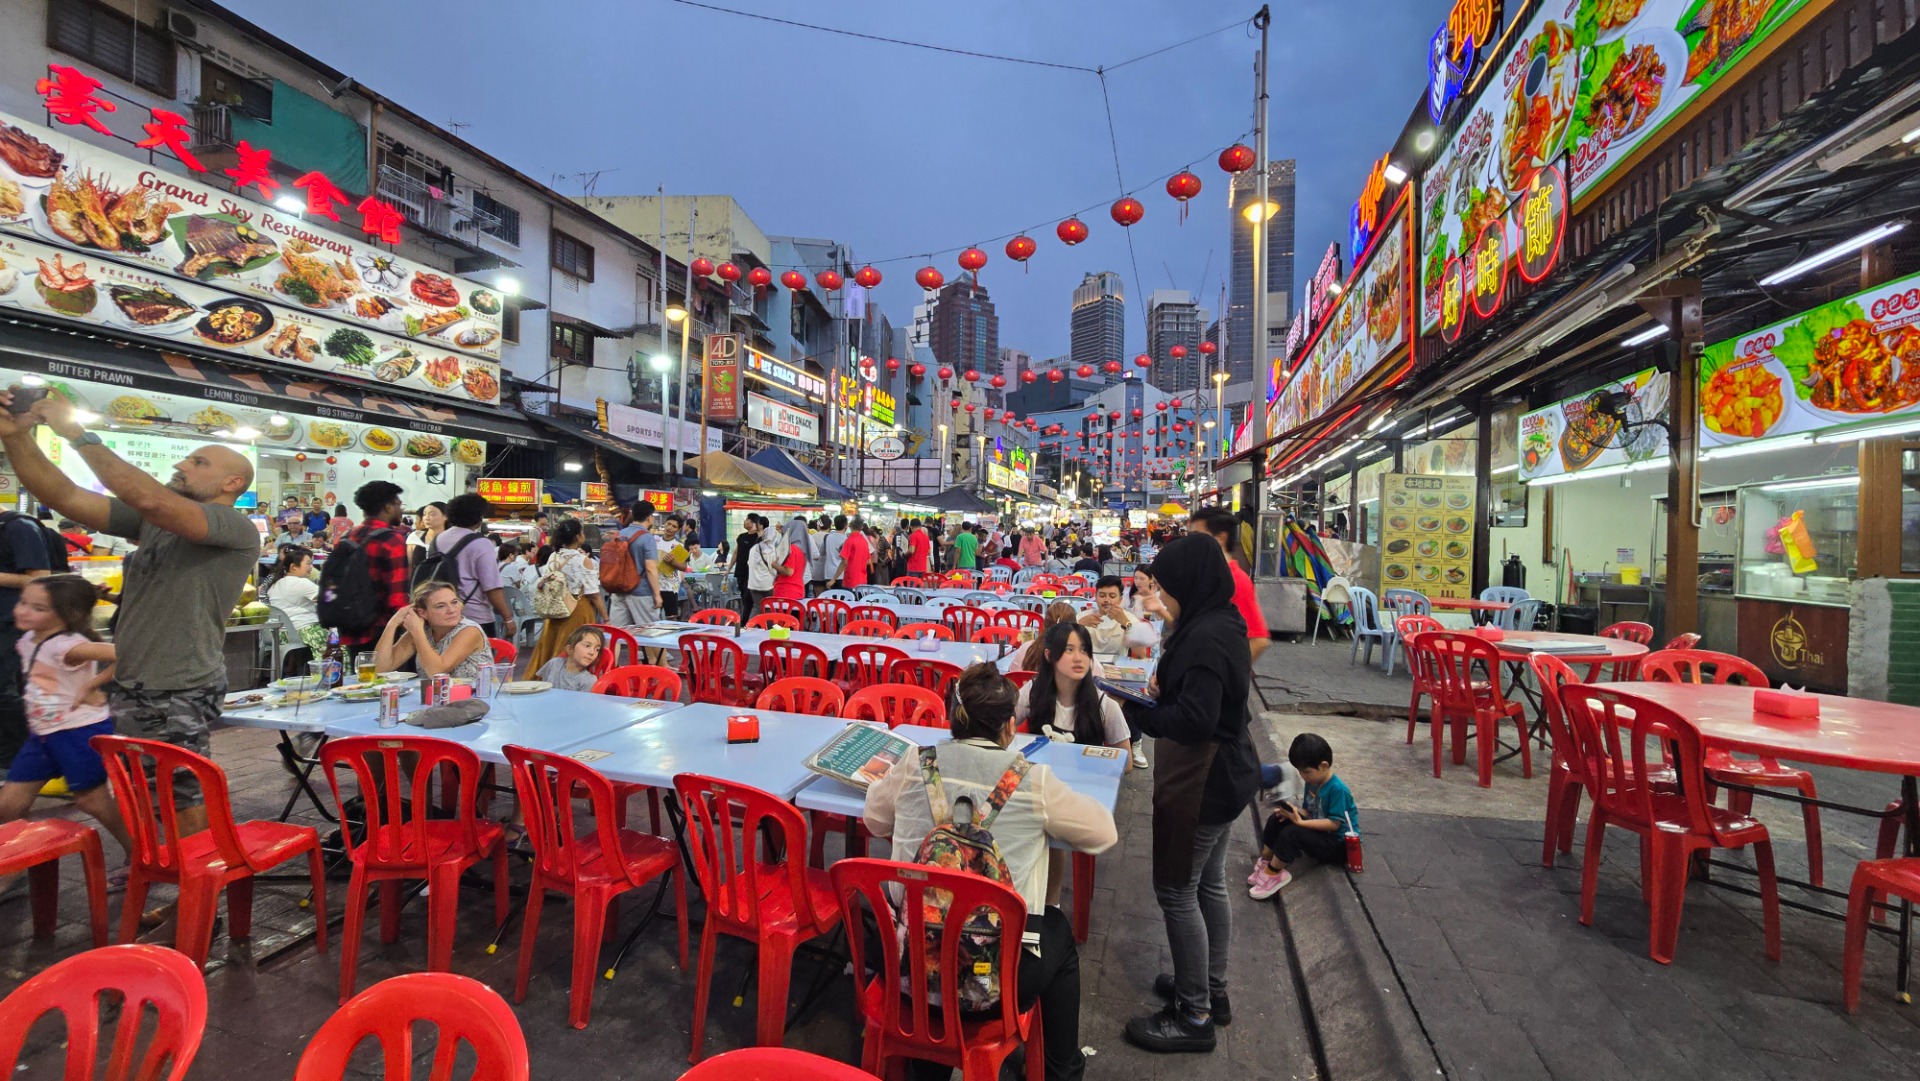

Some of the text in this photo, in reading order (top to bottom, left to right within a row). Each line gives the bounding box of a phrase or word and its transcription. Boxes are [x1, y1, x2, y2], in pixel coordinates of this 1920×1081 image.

[1583, 157, 1607, 177] Cockles
[138, 171, 354, 257] Grand Sky Restaurant
[1876, 319, 1902, 332] Sambal
[711, 337, 736, 358] 4D
[1756, 355, 1775, 364] Chicken
[49, 362, 133, 385] BUTTER PRAWN
[773, 364, 796, 386] SNACK
[204, 388, 258, 405] LEMON SQUID
[317, 406, 363, 421] BBQ STINGRAY
[409, 421, 443, 433] CHILLI CRAB
[627, 425, 652, 437] SPORTS
[1405, 478, 1442, 489] 本地美食
[1800, 648, 1824, 666] Thai
